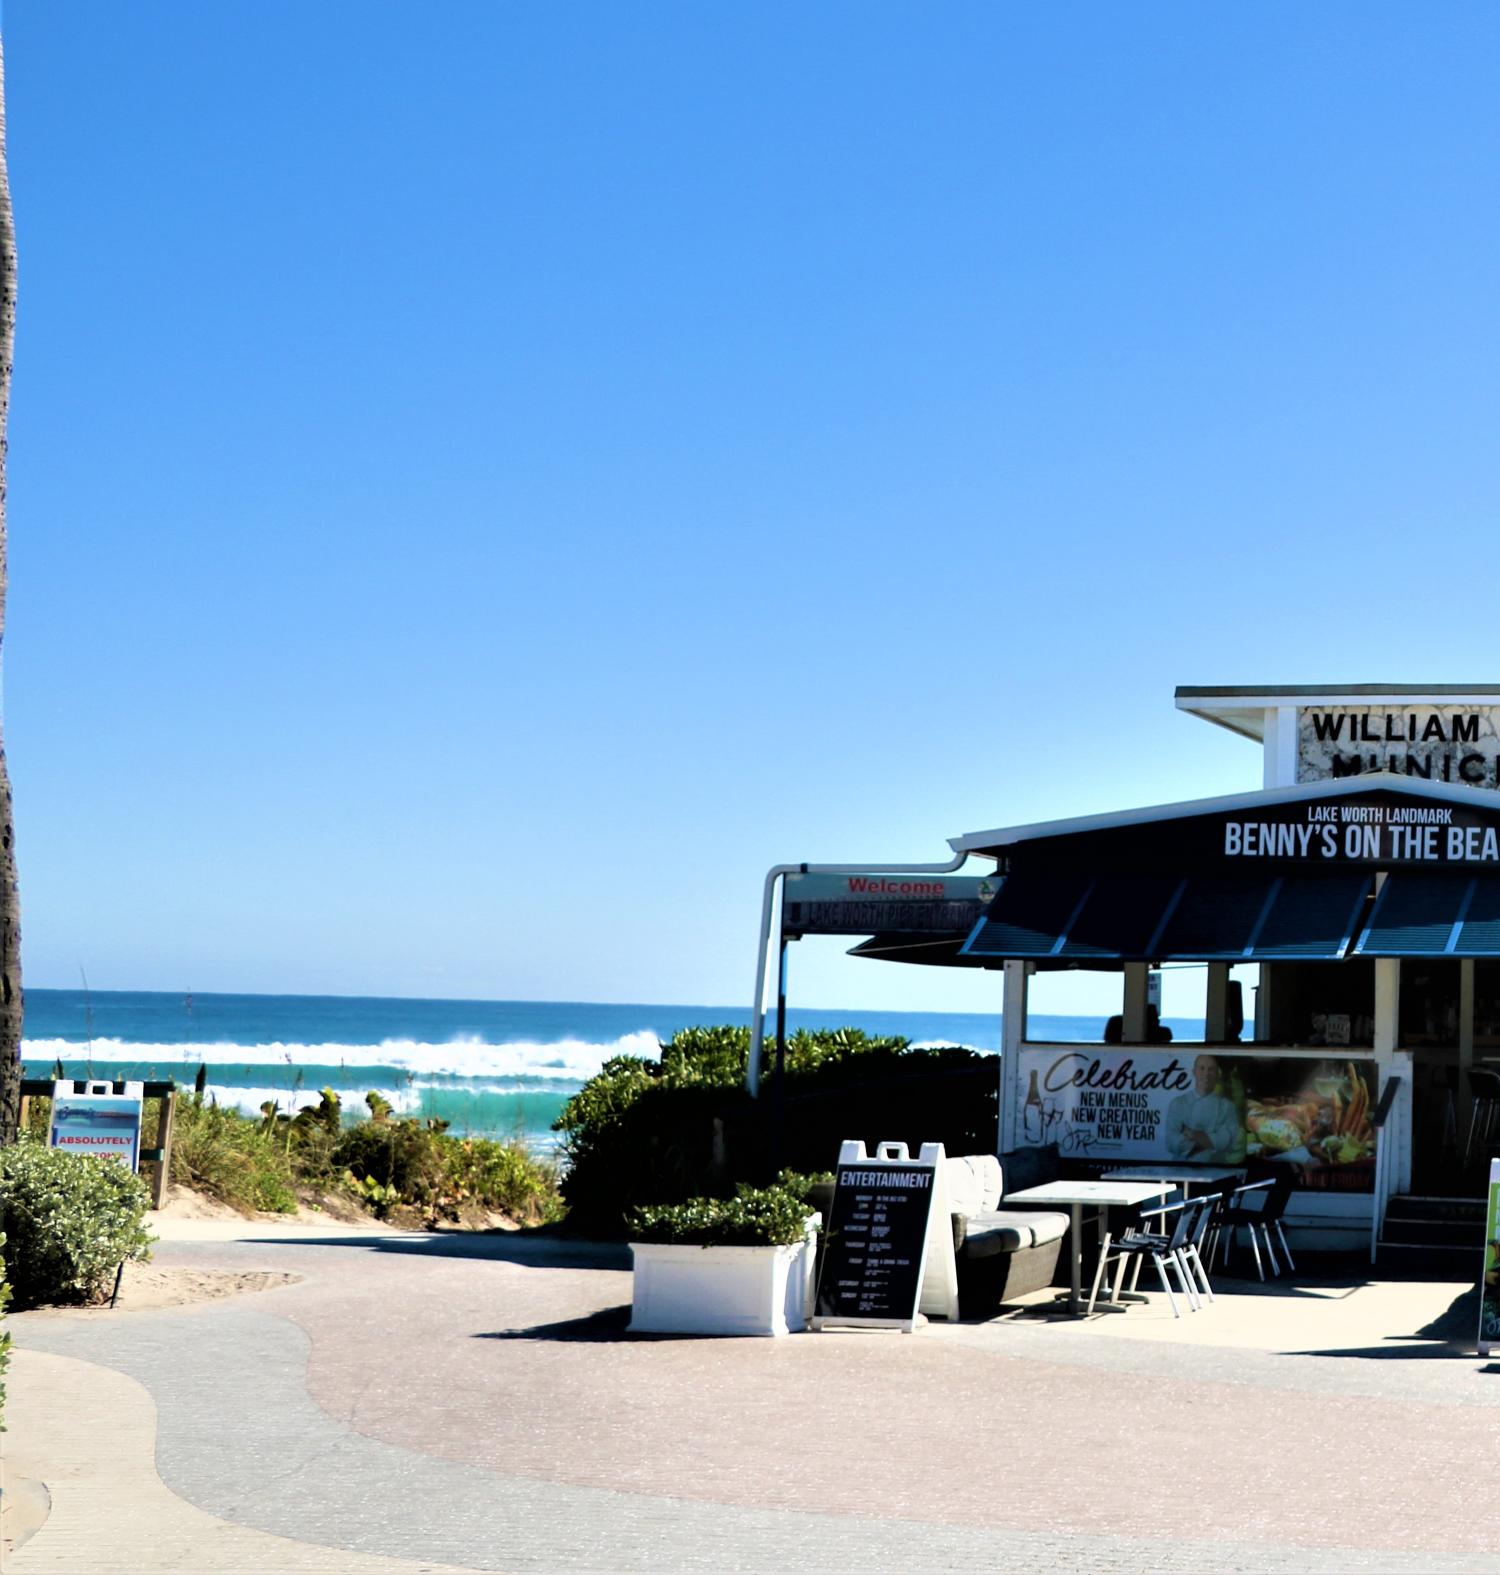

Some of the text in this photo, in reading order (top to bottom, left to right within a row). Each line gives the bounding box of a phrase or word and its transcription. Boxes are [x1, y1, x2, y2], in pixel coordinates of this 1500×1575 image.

[1312, 713, 1480, 742] WILLIAM
[1308, 806, 1453, 824] LAKE WORTH LANDMARK
[1224, 822, 1338, 858] BENNY'S
[1344, 825, 1381, 858] ON
[1388, 826, 1439, 859] THE
[848, 877, 945, 894] Welcome
[1044, 1053, 1192, 1092] Celebrate
[1080, 1092, 1148, 1108] NEW MENUS
[1072, 1107, 1161, 1125] NEW CREATIONS
[59, 1136, 133, 1145] ABSOLUTELY
[1097, 1124, 1122, 1139] NEW
[1126, 1125, 1155, 1140] YEAR
[840, 1171, 932, 1188] ENTERTAINMENT
